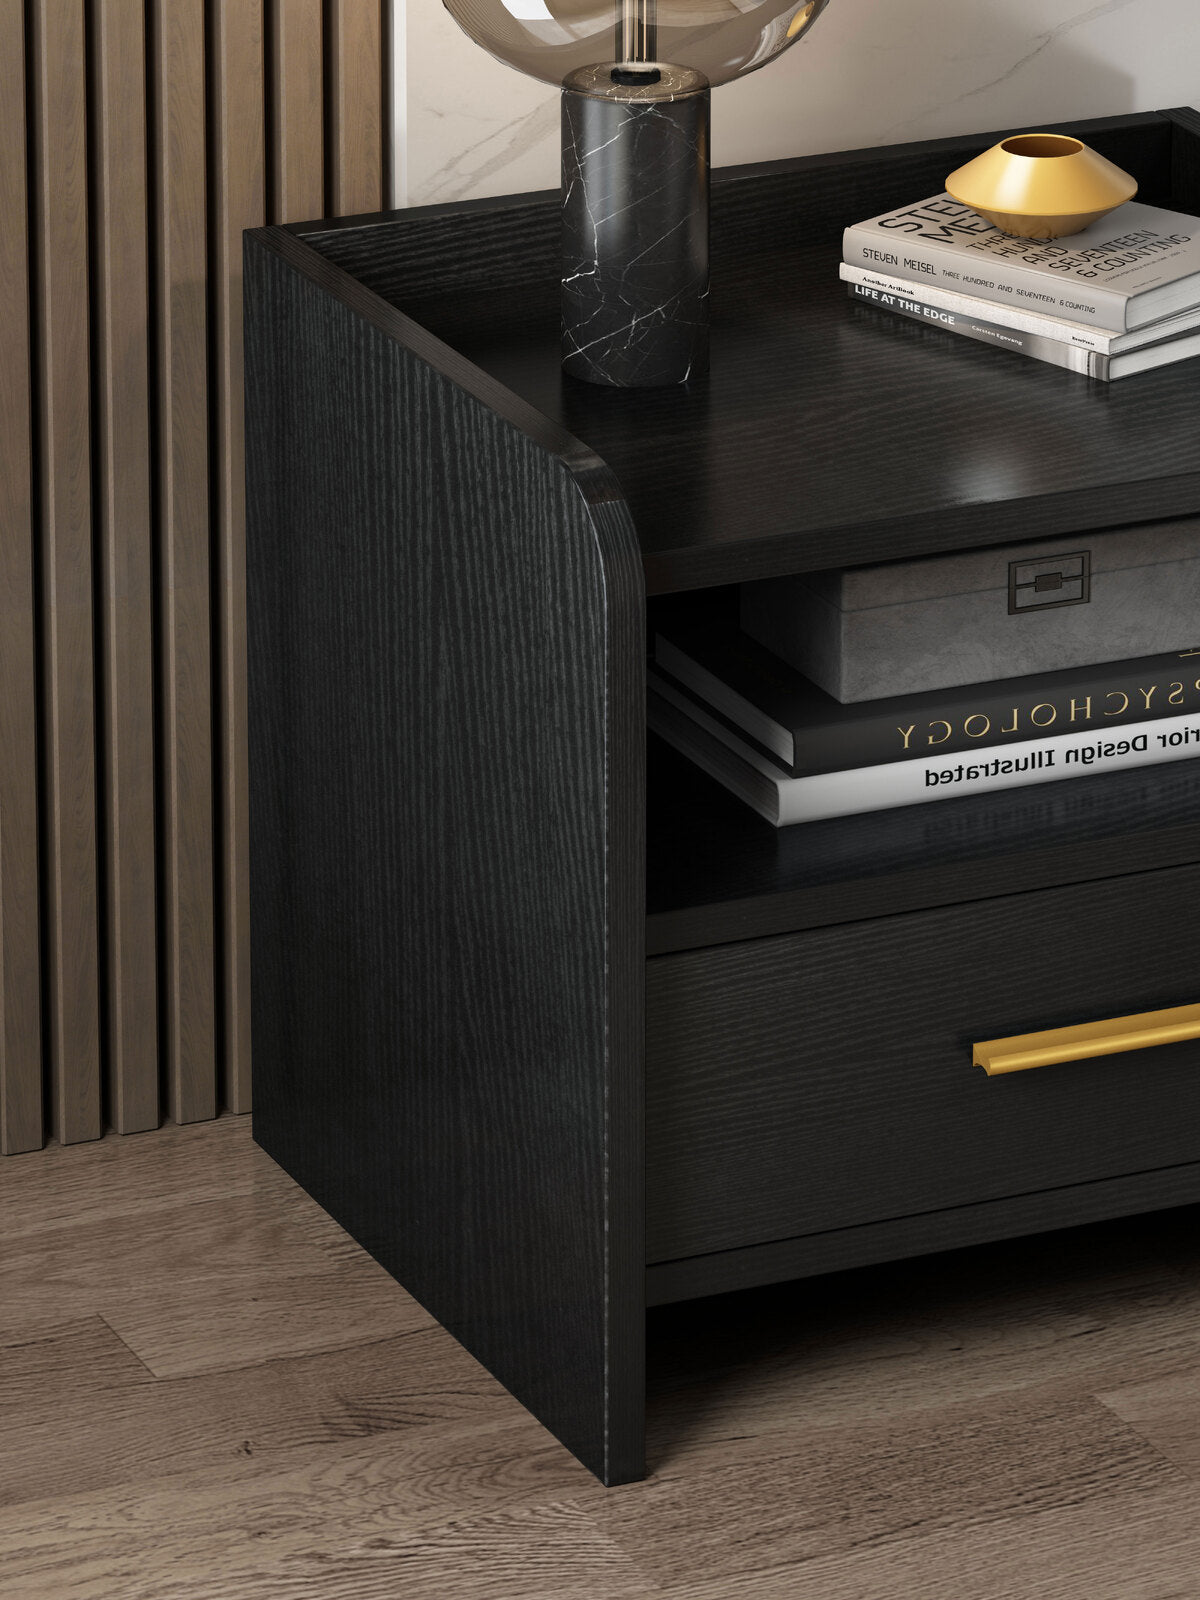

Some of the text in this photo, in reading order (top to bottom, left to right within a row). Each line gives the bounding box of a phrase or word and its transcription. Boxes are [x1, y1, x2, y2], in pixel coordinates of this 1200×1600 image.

[1022, 246, 1068, 265] AND
[1048, 229, 1159, 272] SEVENTEEN
[1093, 234, 1191, 271] COUNTING
[862, 248, 898, 265] STEVEN
[903, 258, 937, 276] MEISEL
[942, 269, 961, 280] THREE
[963, 275, 994, 289] HUNDRED
[997, 284, 1013, 293] AND
[1016, 289, 1056, 304] SEVENTEEN
[1065, 300, 1096, 314] COUNTING
[862, 277, 887, 288] Another
[855, 285, 955, 325] LIFE AT THE EDGE
